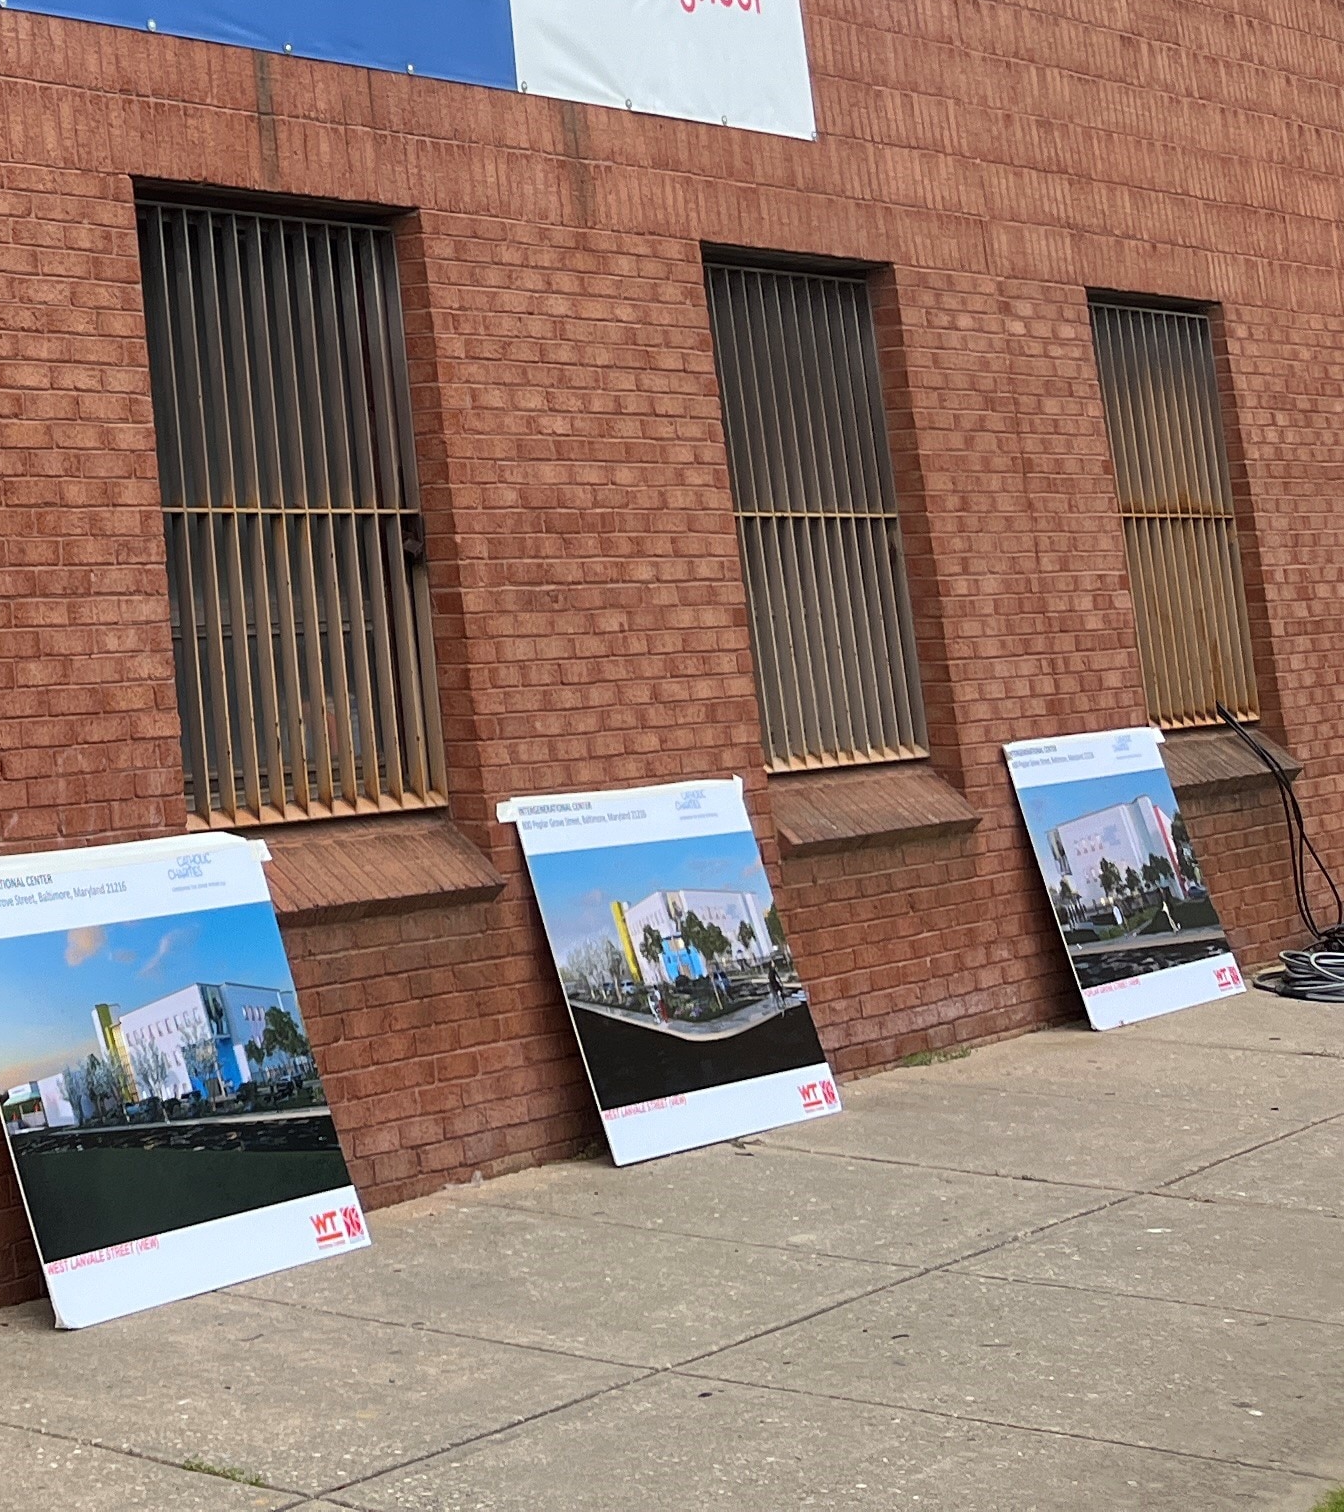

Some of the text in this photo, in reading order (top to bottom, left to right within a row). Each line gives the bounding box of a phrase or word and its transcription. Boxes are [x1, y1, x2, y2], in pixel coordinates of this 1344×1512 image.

[26, 873, 53, 887] CENTER
[73, 885, 105, 899] Maryland
[309, 1210, 337, 1235] WT
[106, 1243, 134, 1261] STREET
